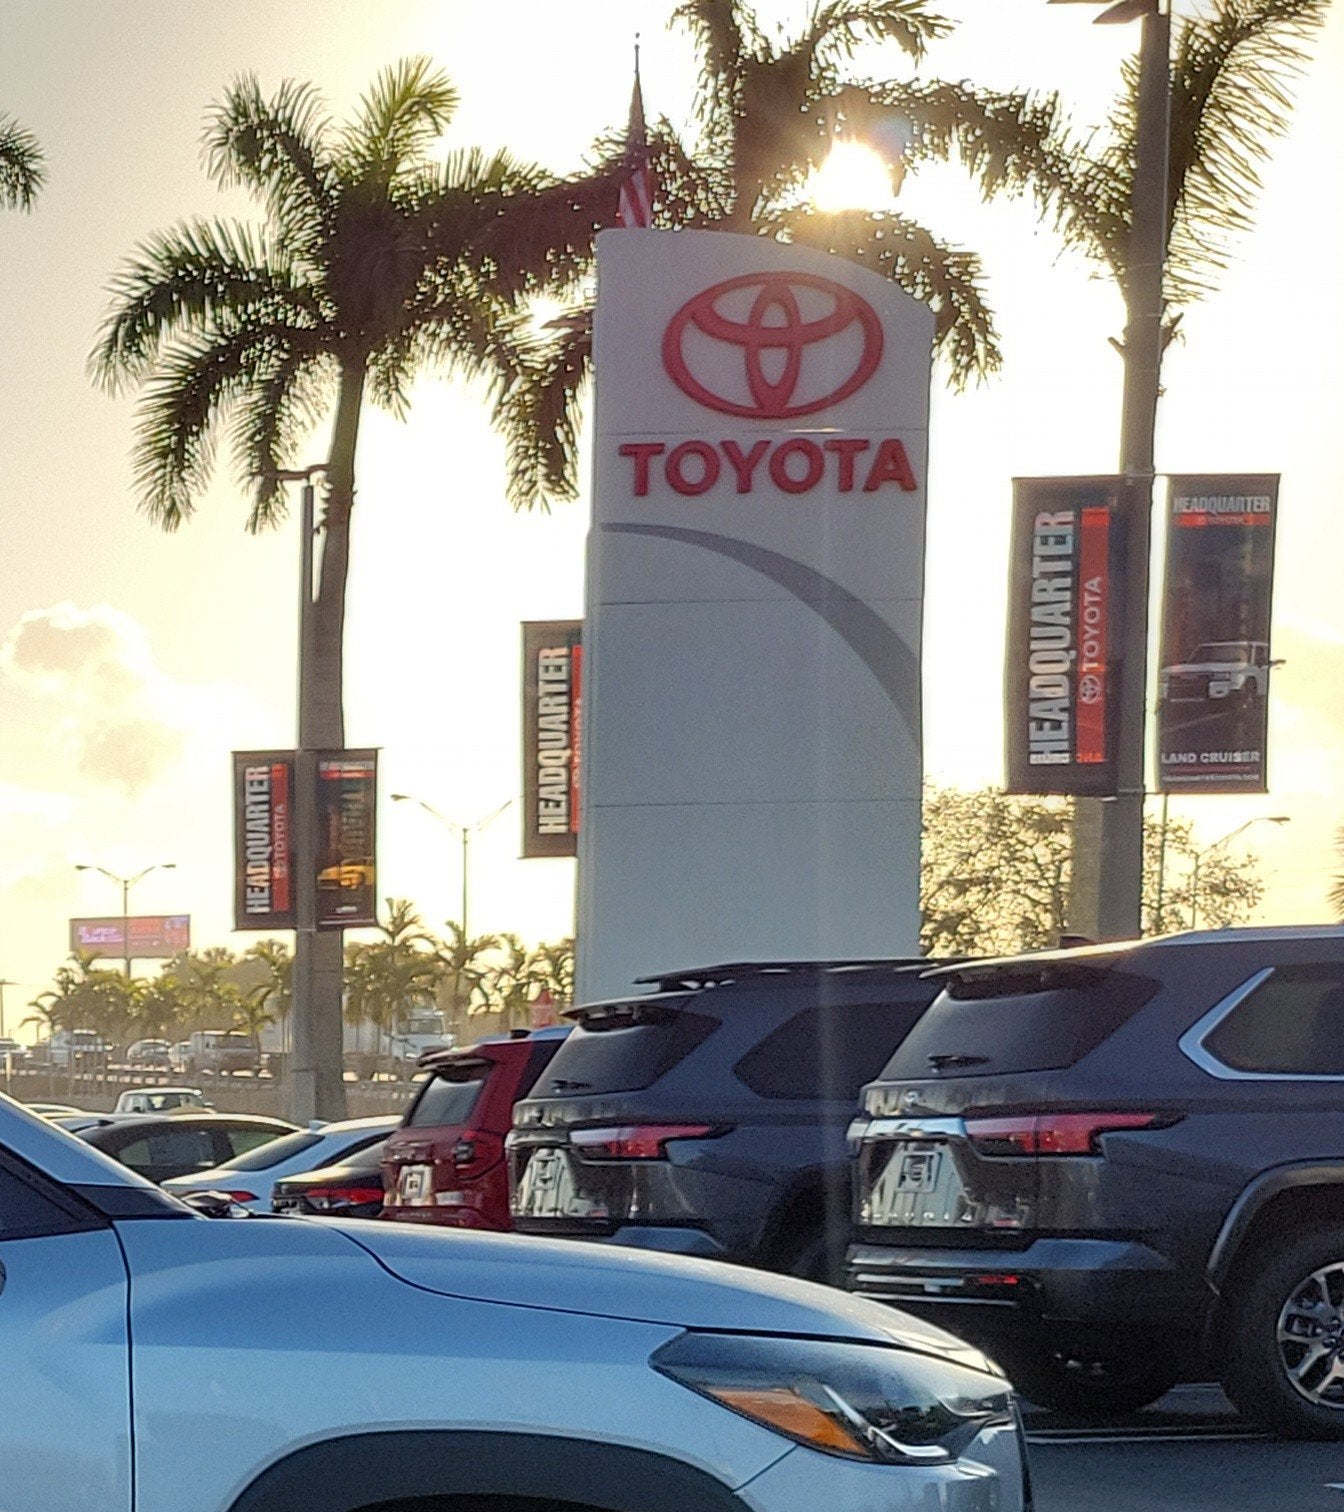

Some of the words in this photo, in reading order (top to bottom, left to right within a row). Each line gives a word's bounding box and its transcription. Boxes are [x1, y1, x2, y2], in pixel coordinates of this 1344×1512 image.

[618, 438, 917, 496] TOYOTA
[1173, 496, 1271, 514] HEADQUARTER
[1029, 510, 1075, 765] HEADQUARTER
[1081, 576, 1103, 672] TOYOTA
[538, 647, 570, 834] HEADQUARTER
[1161, 753, 1197, 764] LAND
[1200, 751, 1260, 763] CRUISER
[245, 766, 271, 914] HEADQUARTER
[274, 803, 287, 860] TOYOTA
